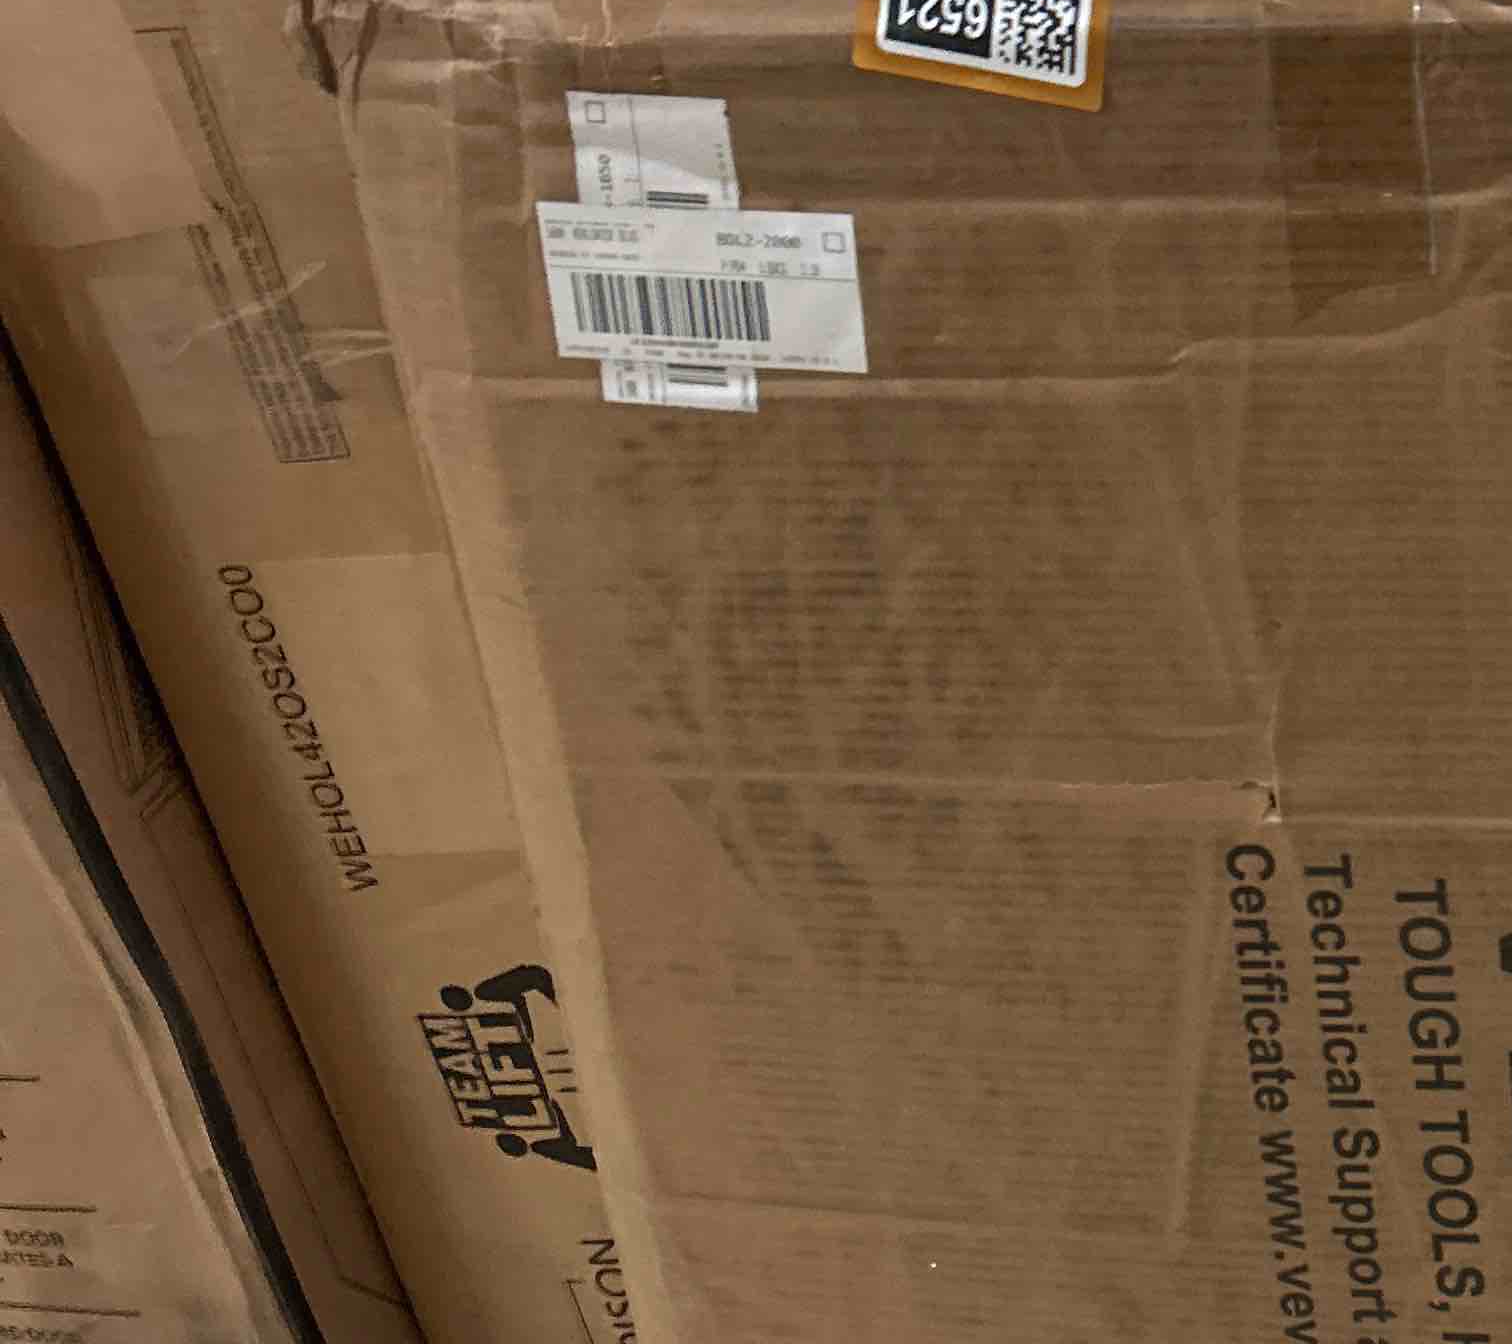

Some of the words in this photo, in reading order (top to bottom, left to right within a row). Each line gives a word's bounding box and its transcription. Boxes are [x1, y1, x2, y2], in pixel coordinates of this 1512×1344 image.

[423, 1017, 496, 1124] TEAM
[466, 1015, 552, 1127] LIFT
[1226, 843, 1289, 1114] Certificate
[1302, 853, 1375, 1112] Technical
[1394, 877, 1466, 1094] TOUGH
[1330, 1127, 1392, 1323] Support
[1419, 1108, 1487, 1312] TOOLS,
